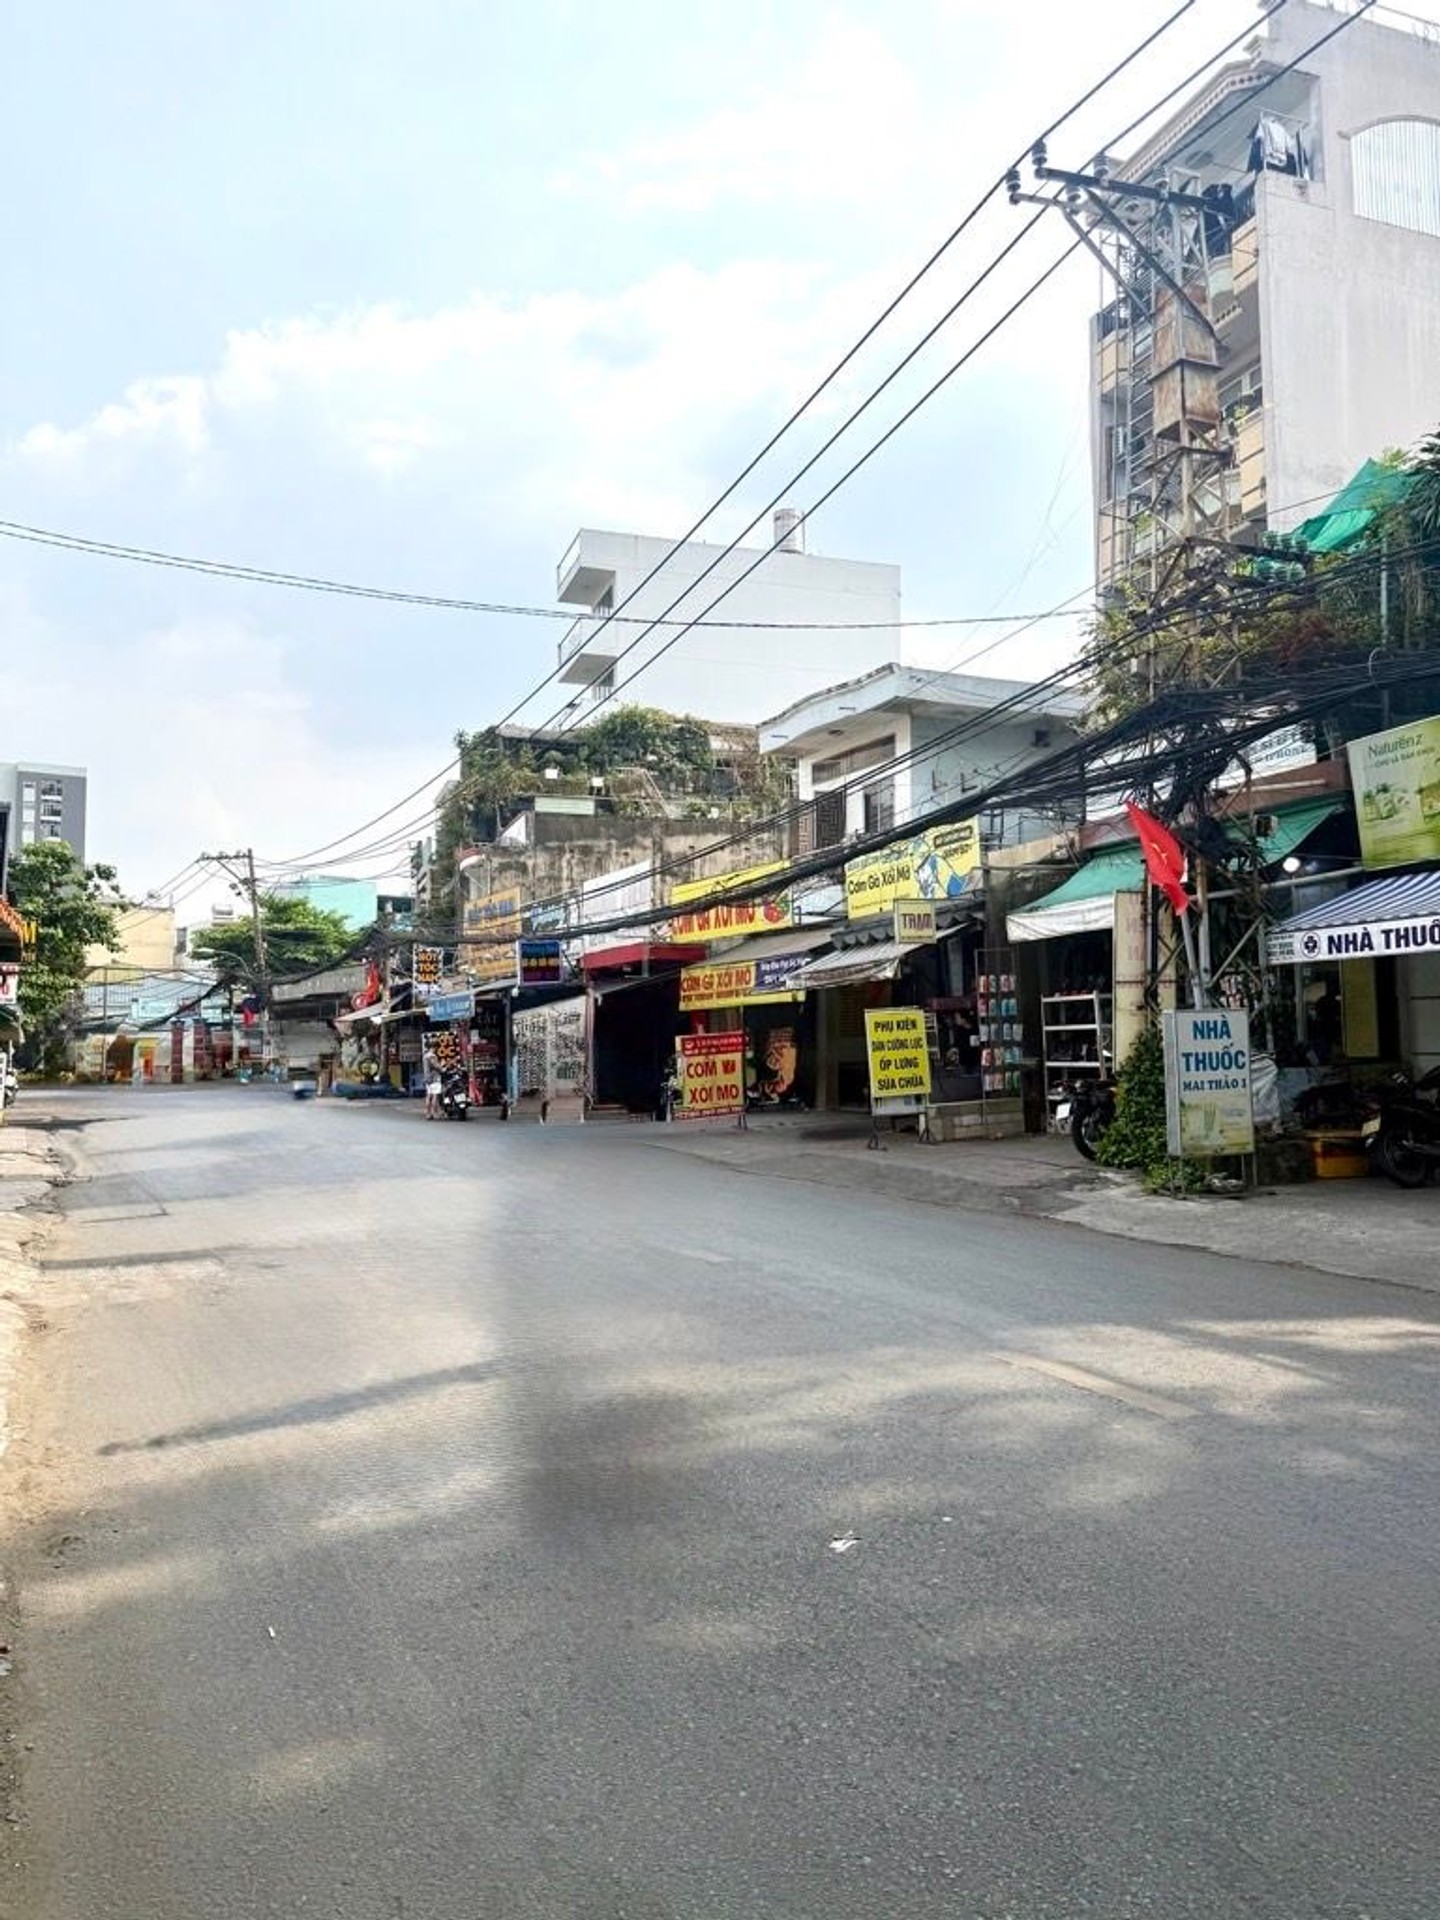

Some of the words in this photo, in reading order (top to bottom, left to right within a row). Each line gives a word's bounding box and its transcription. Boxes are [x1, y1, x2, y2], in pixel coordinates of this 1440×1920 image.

[1327, 926, 1375, 955] NHÀ
[1192, 1013, 1231, 1041] NHÀ
[1181, 1042, 1246, 1073] THUỐC
